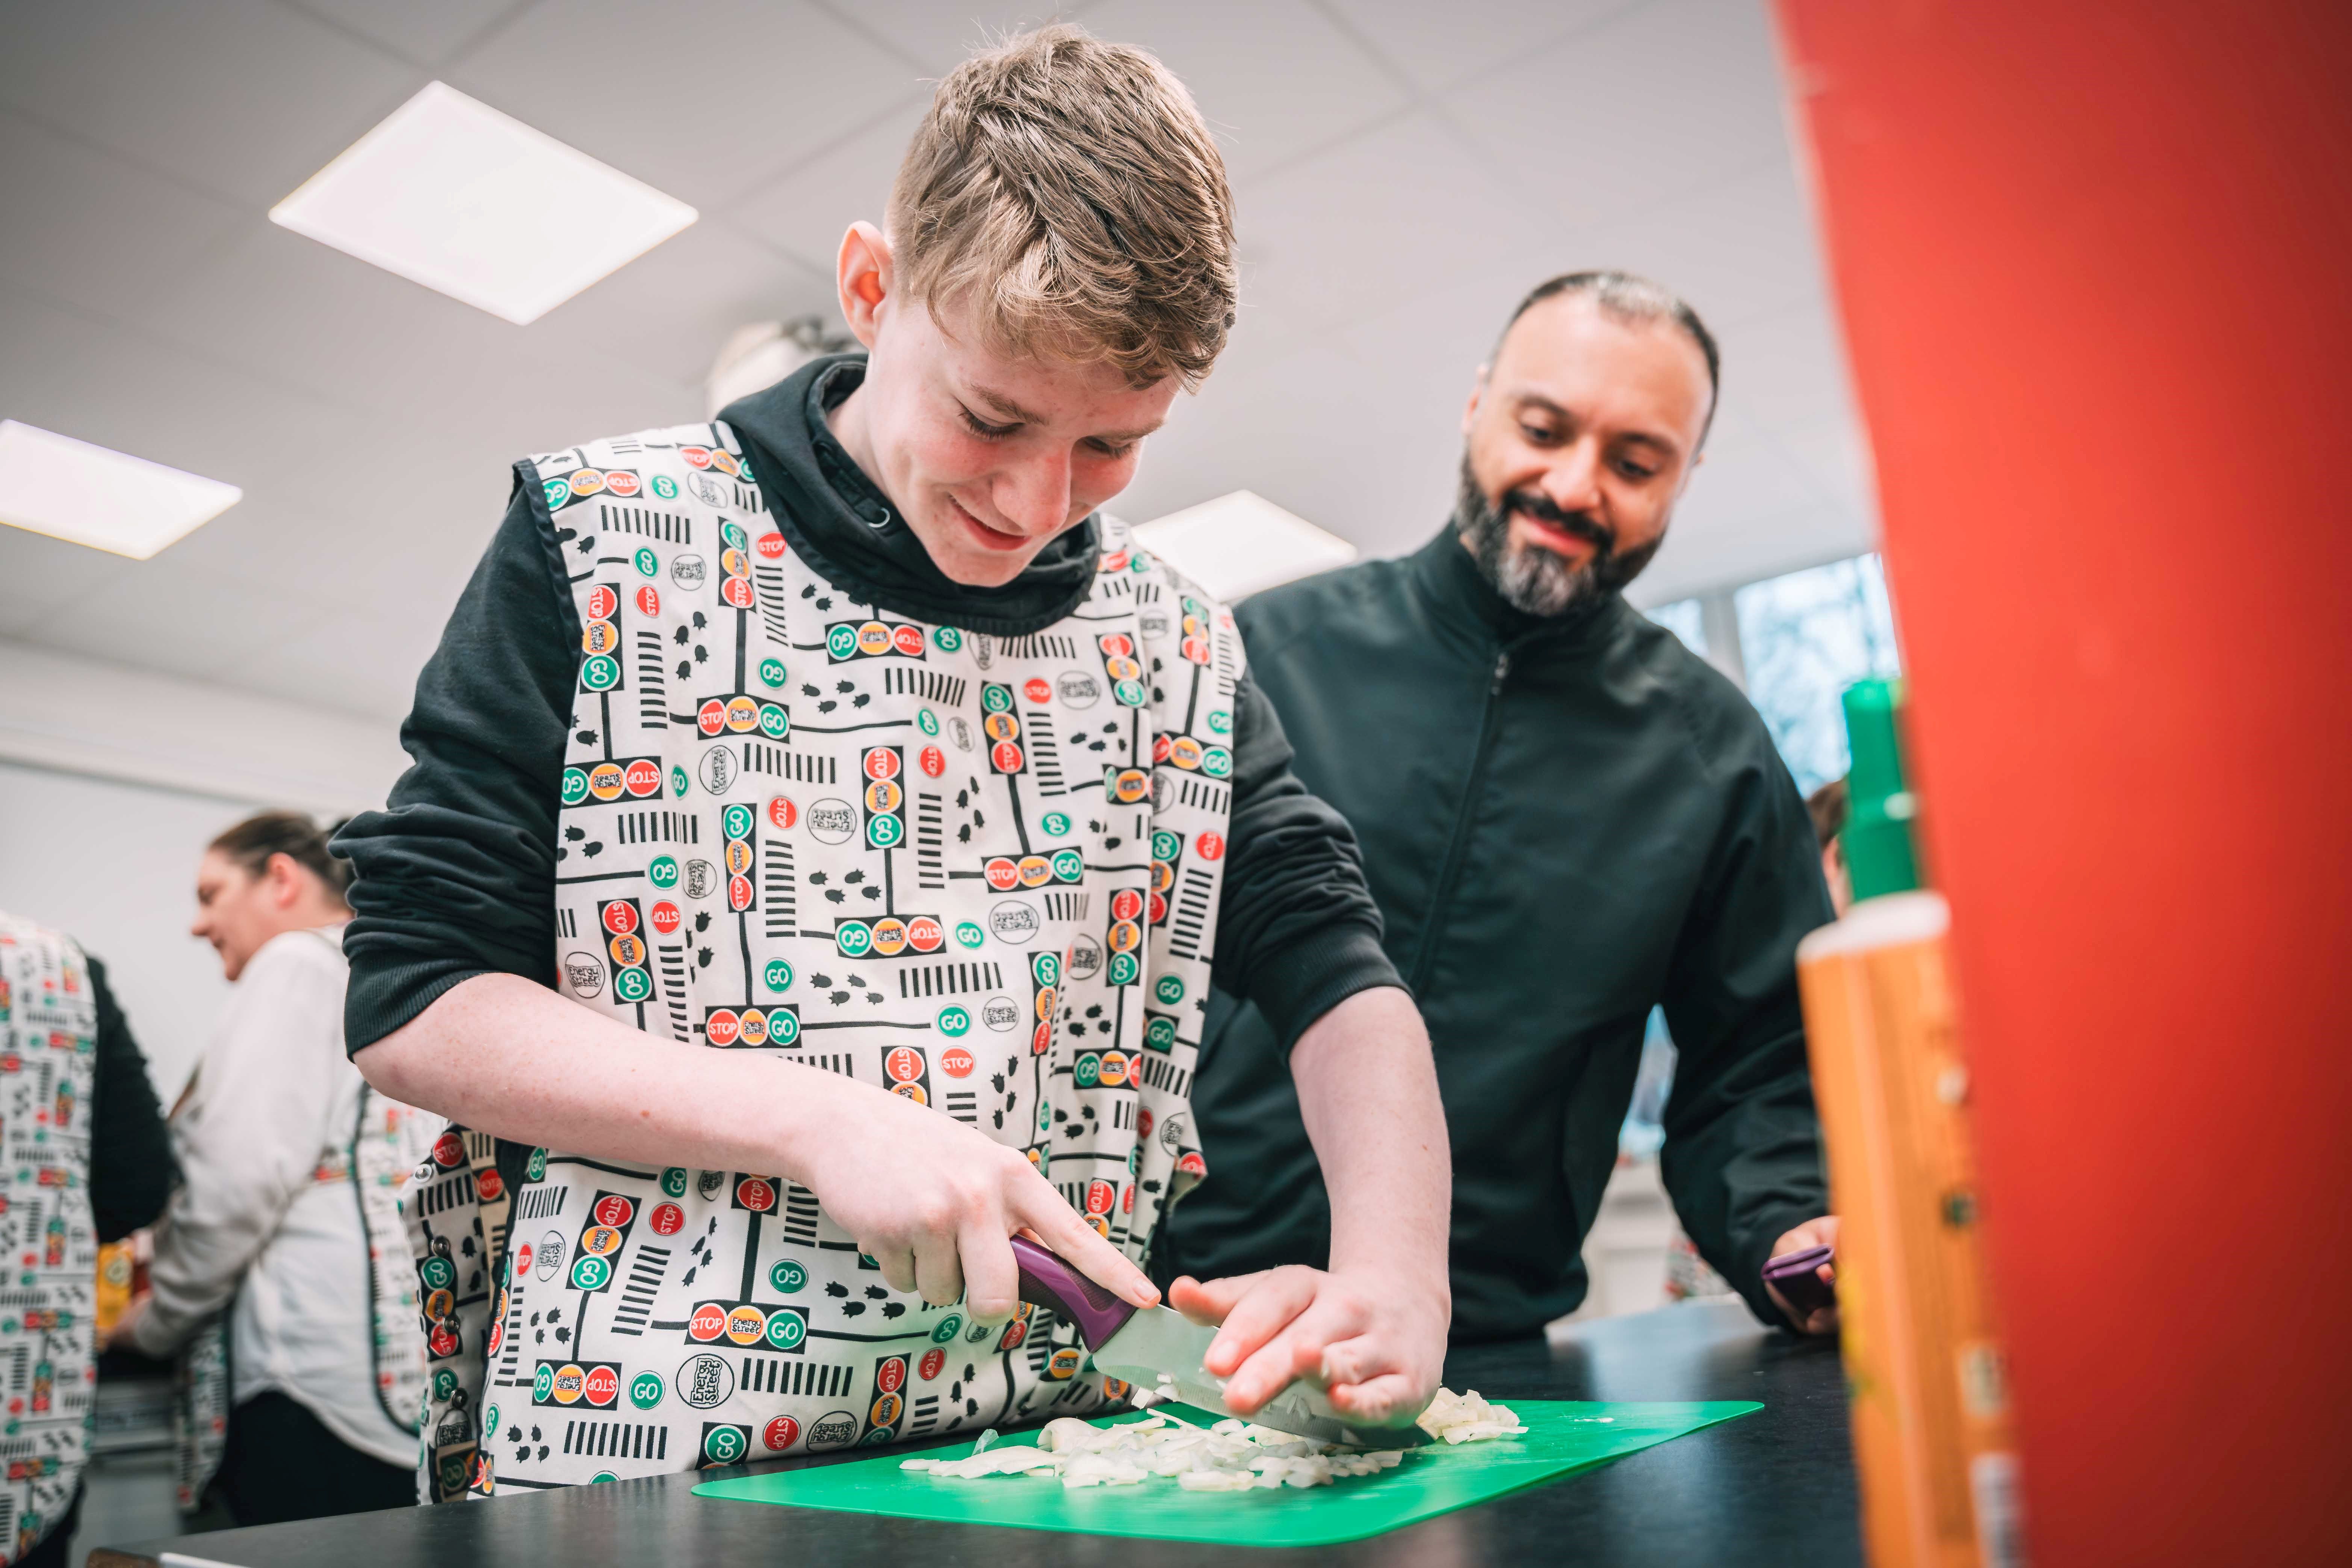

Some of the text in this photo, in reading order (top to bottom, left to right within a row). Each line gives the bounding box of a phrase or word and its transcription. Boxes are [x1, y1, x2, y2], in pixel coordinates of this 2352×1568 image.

[609, 477, 638, 487] STOP
[657, 478, 674, 497] GO
[729, 526, 744, 548] GO
[759, 540, 786, 552] STOP
[641, 552, 653, 574] GO
[646, 587, 656, 615] STOP
[735, 580, 746, 605] STOP
[591, 588, 603, 617] STOP
[832, 632, 854, 650] GO
[895, 634, 923, 647] STOP
[940, 628, 957, 648] GO
[590, 659, 609, 684] GO
[763, 664, 784, 681] GO
[989, 689, 1005, 710] GO
[701, 711, 723, 725] STOP
[762, 712, 784, 730] GO
[922, 711, 936, 733] GO
[875, 751, 887, 777] STOP
[928, 747, 939, 775] STOP
[1002, 744, 1015, 770] STOP
[1206, 755, 1227, 772] GO
[628, 771, 658, 783] STOP
[713, 750, 721, 788] Energy
[719, 751, 727, 788] Street
[563, 776, 584, 794] GO
[776, 799, 787, 827] STOP
[729, 810, 744, 835] GO
[875, 817, 893, 842] GO
[1046, 815, 1065, 835] GO
[1155, 835, 1172, 857] GO
[653, 864, 677, 880] GO
[989, 869, 1016, 880] STOP
[1057, 858, 1079, 874] GO
[735, 878, 744, 907] STOP
[1120, 893, 1132, 918] STOP
[613, 903, 628, 931] STOP
[653, 911, 679, 922] STOP
[842, 930, 868, 947] GO
[911, 927, 939, 939] STOP
[957, 928, 981, 943] GO
[568, 965, 599, 977] Energy
[767, 968, 789, 984] GO
[1041, 959, 1055, 983] GO
[1114, 957, 1128, 980] GO
[571, 976, 600, 987] Street
[624, 972, 643, 995] GO
[1159, 982, 1181, 998] GO
[709, 1023, 738, 1034] STOP
[772, 1019, 793, 1036] GO
[941, 1014, 966, 1030] GO
[1150, 1027, 1170, 1043] GO
[898, 1051, 911, 1079] STOP
[943, 1057, 972, 1069] STOP
[1080, 1062, 1098, 1078] GO
[435, 1143, 461, 1160] STOP
[531, 1155, 543, 1172] GO
[750, 1182, 763, 1209] STOP
[1091, 1183, 1104, 1211] STOP
[604, 1198, 622, 1225] STOP
[660, 1207, 676, 1233] STOP
[591, 1230, 604, 1252] Street
[600, 1229, 613, 1252] Energy
[430, 1263, 447, 1285] GO
[580, 1261, 600, 1284] GO
[776, 1269, 801, 1284] GO
[692, 1317, 723, 1329] STOP
[732, 1317, 761, 1328] Energy
[732, 1325, 760, 1334] Street
[771, 1322, 798, 1340] GO
[939, 1322, 954, 1338] GO
[926, 1351, 938, 1377] STOP
[536, 1374, 550, 1391] GO
[559, 1375, 581, 1384] Street
[693, 1360, 713, 1402] Energy
[705, 1361, 721, 1402] Street
[886, 1361, 897, 1390] STOP
[557, 1382, 580, 1391] Energy
[588, 1379, 615, 1391] STOP
[634, 1383, 658, 1400] GO
[488, 1410, 495, 1434] GO
[818, 1423, 851, 1432] Street
[774, 1419, 789, 1447] STOP
[814, 1431, 850, 1441] Energy
[717, 1433, 736, 1458] GO
